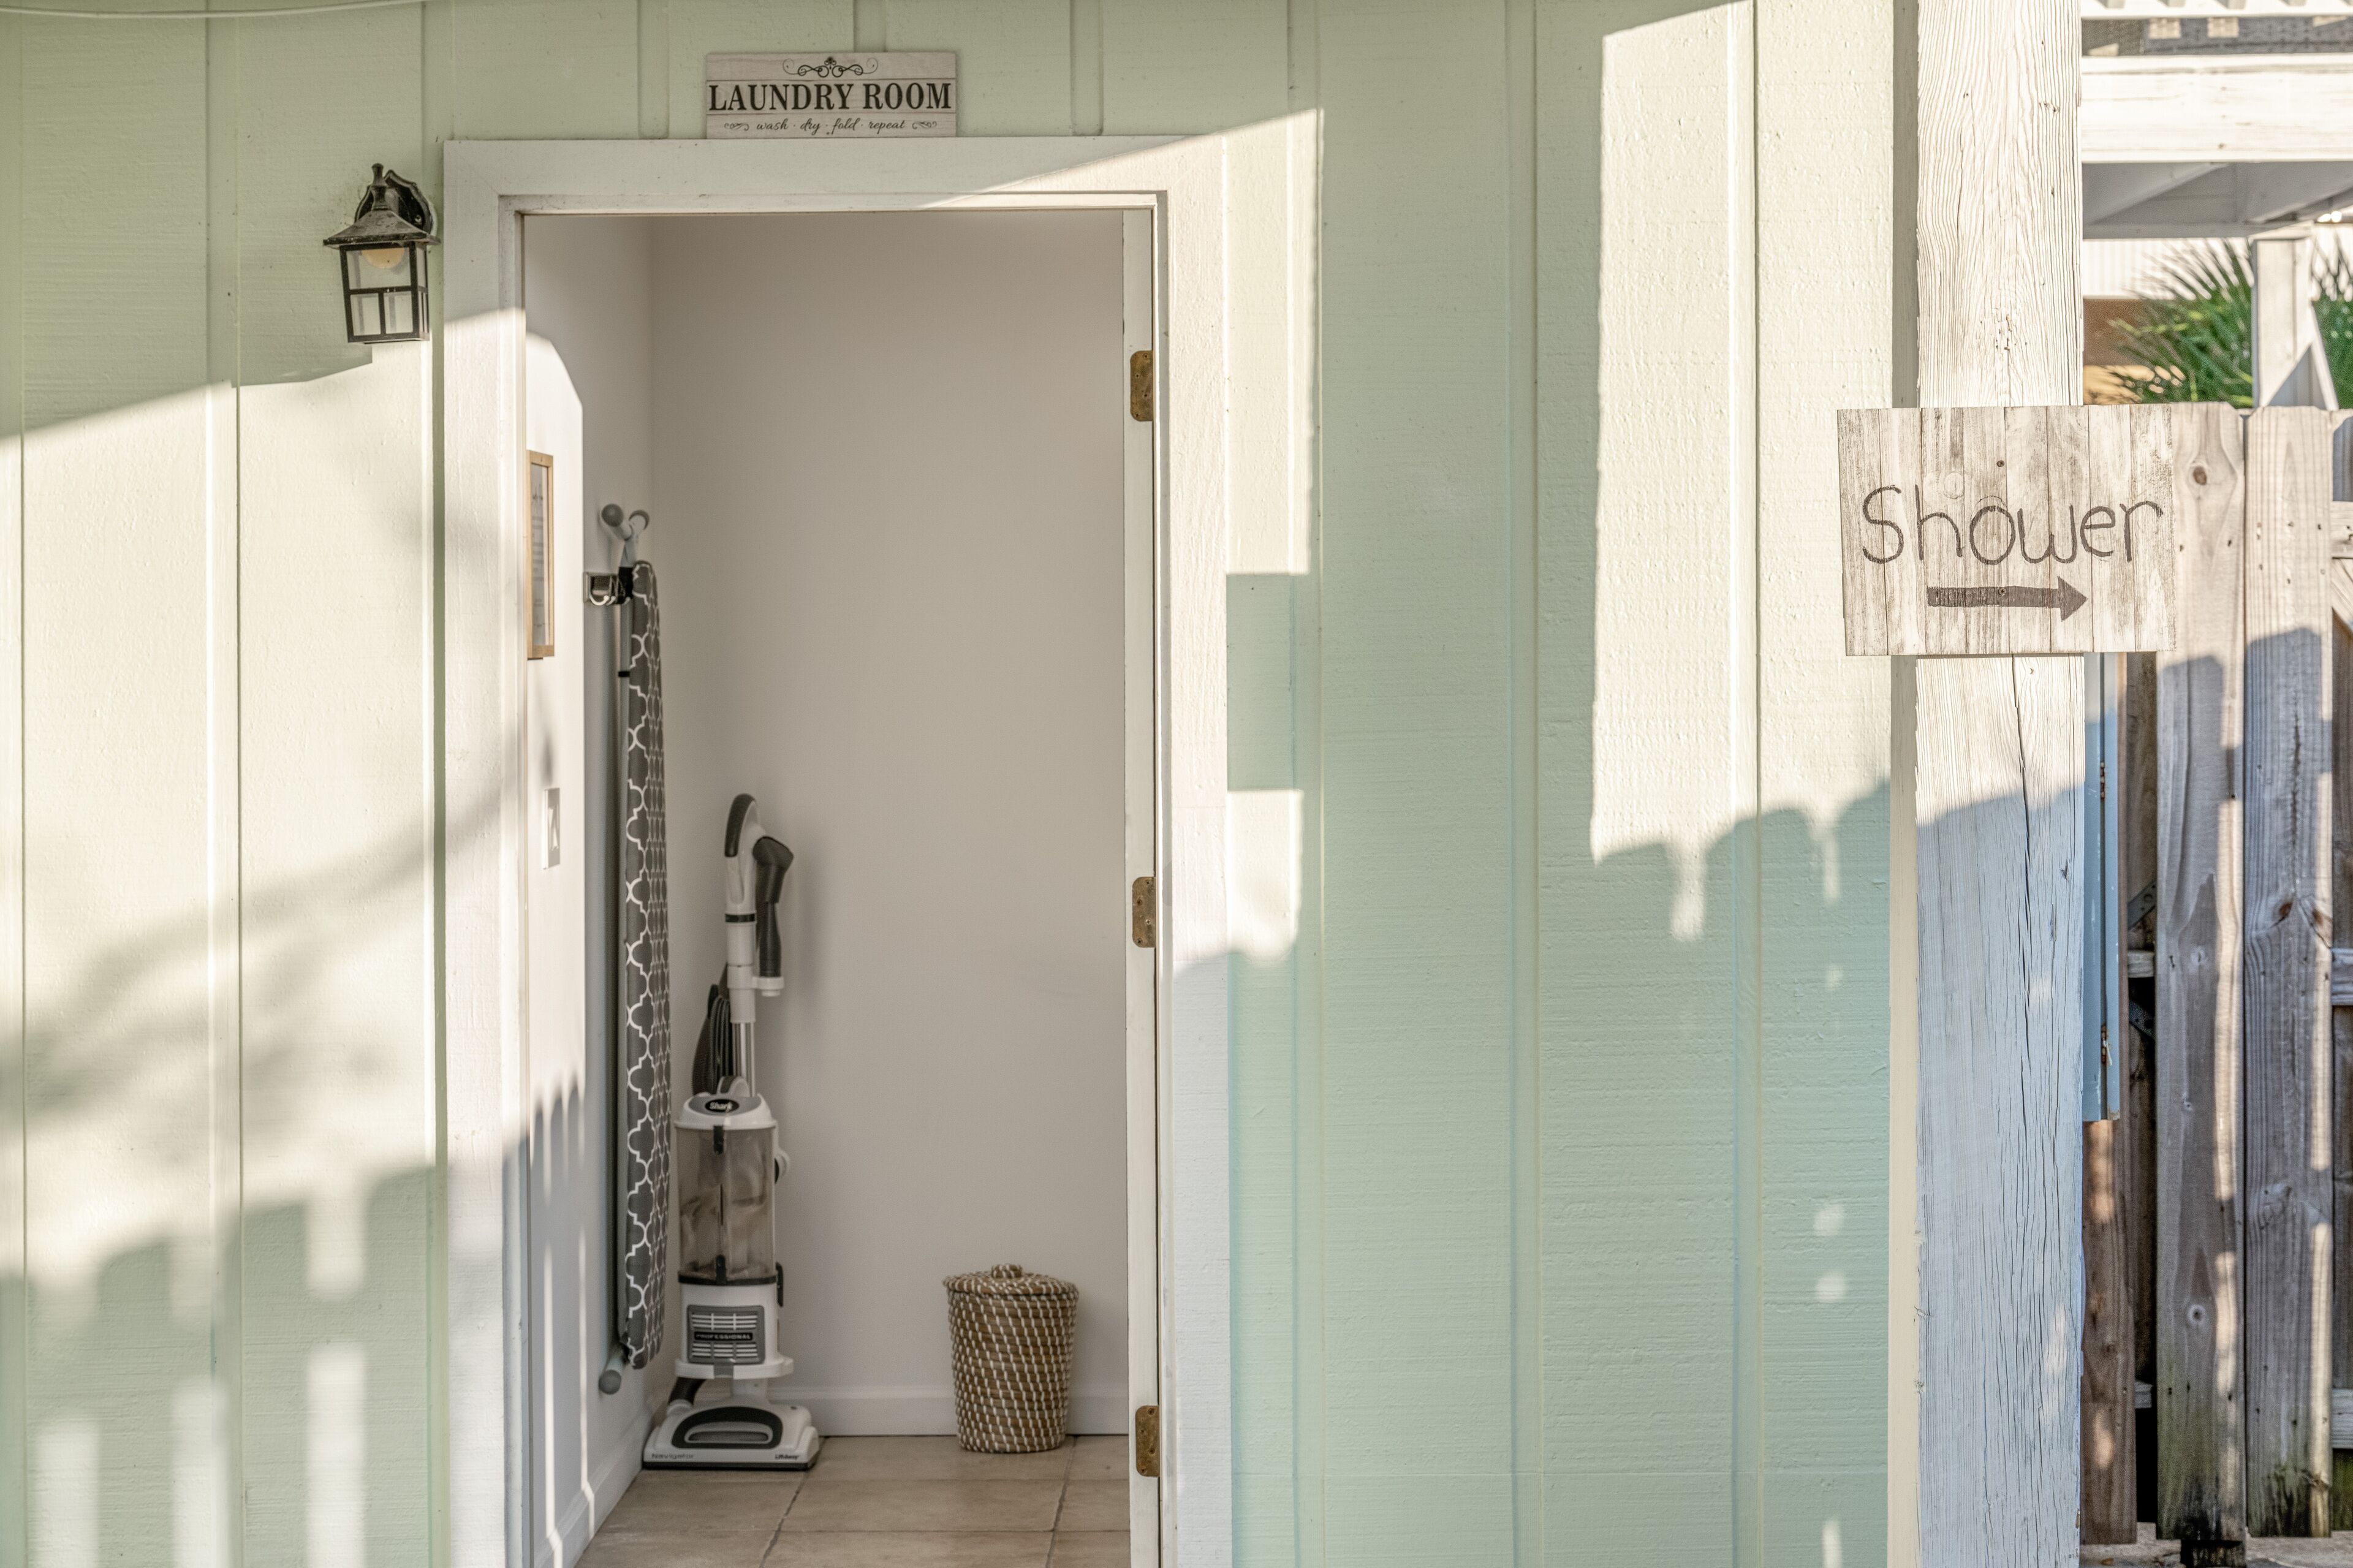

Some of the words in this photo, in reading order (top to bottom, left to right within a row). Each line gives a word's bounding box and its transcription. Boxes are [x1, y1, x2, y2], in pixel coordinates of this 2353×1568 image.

[709, 83, 854, 110] LAUNDRY
[863, 83, 952, 110] ROOM
[756, 118, 789, 131] wash
[800, 118, 822, 135] dry
[830, 118, 860, 135] fold
[868, 120, 905, 134] repeat
[1862, 484, 2164, 565] Shower
